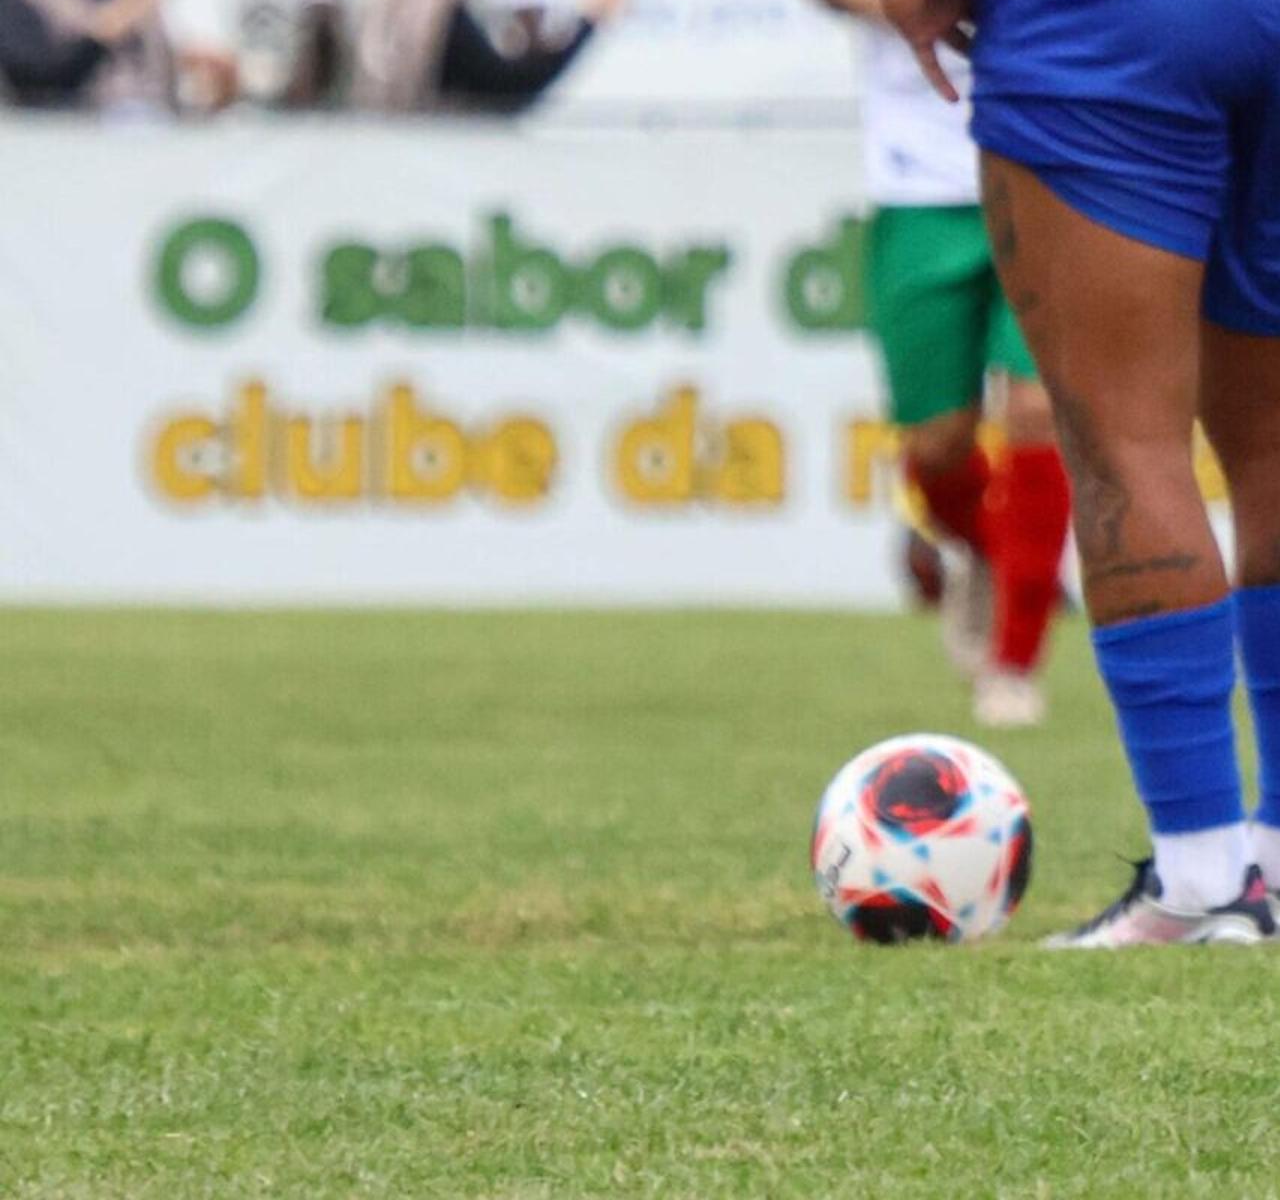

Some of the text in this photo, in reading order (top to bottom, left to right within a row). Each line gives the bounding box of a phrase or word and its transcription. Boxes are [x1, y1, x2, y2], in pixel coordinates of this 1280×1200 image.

[157, 217, 260, 328] O
[320, 211, 730, 330] sabor
[152, 380, 558, 502] clube
[614, 384, 786, 502] da
